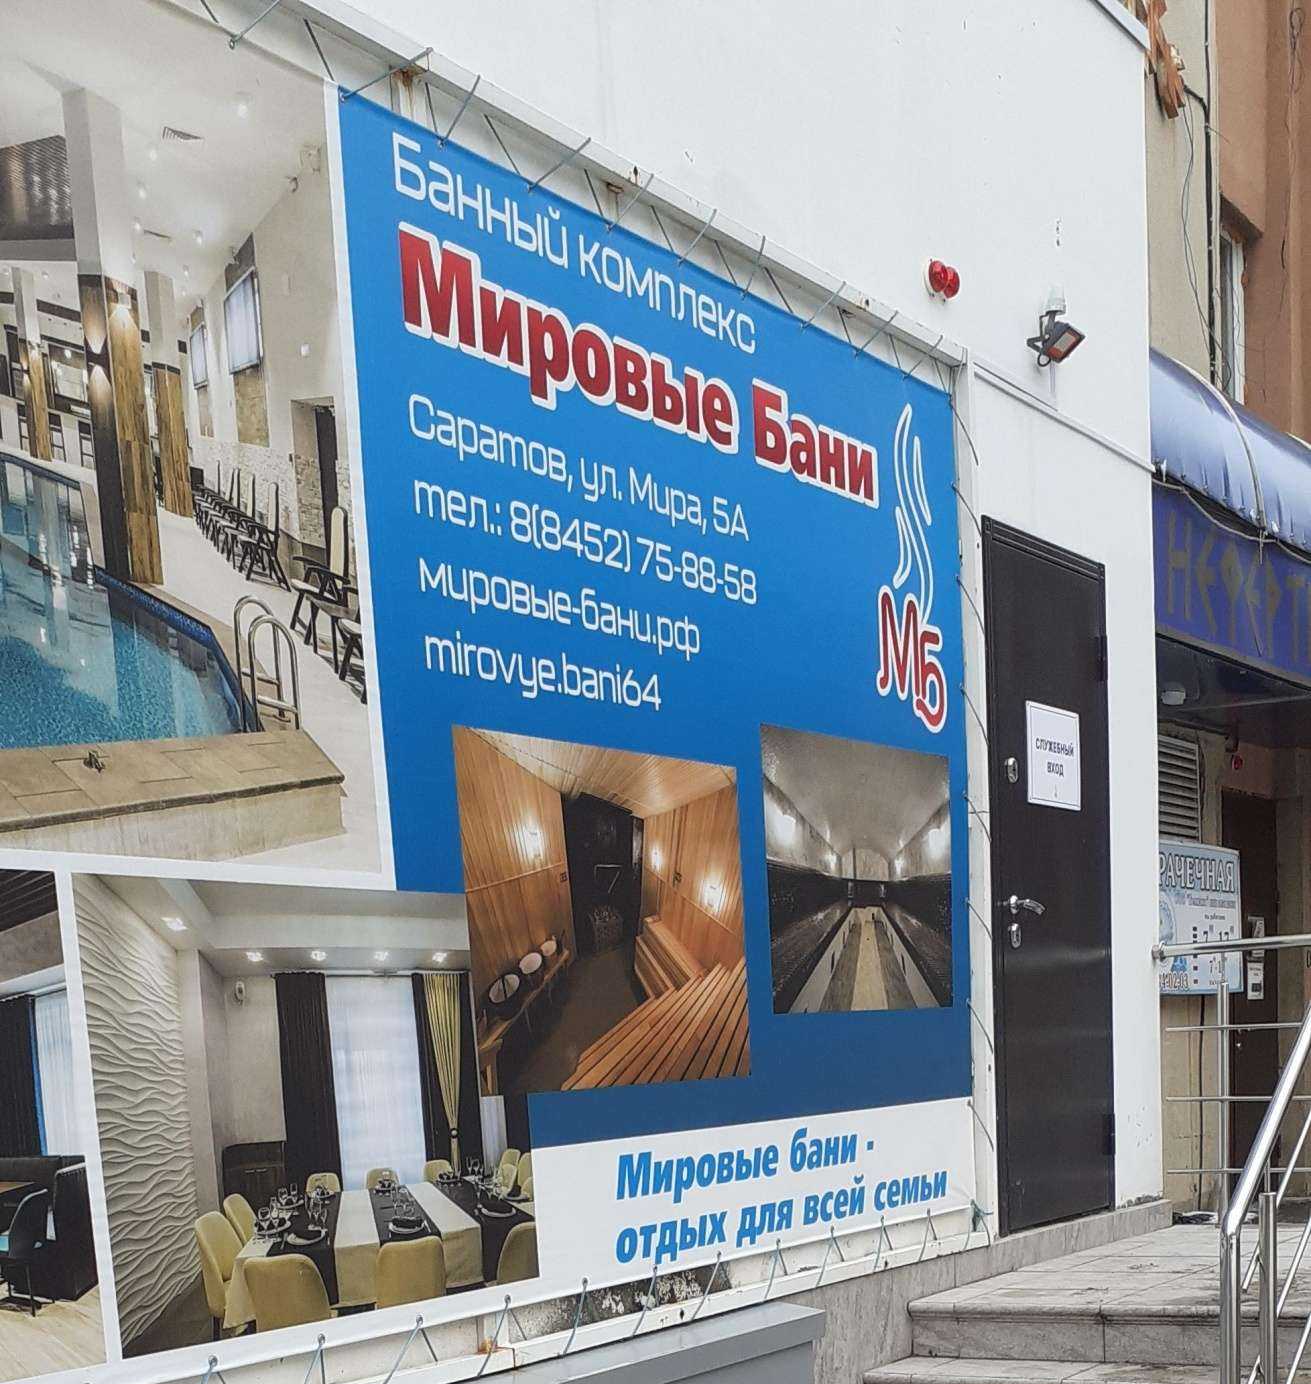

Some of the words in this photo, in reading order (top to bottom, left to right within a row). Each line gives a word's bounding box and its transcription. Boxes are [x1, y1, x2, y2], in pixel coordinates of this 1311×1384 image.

[392, 132, 569, 268] Банный
[578, 231, 756, 354] комплекс
[399, 222, 738, 453] Мировые
[751, 379, 879, 508] Бани
[409, 393, 573, 492] Саратов,
[580, 457, 623, 502] ул.
[630, 467, 708, 534] Мира,
[414, 479, 502, 534] тел.:
[510, 500, 632, 574] 8(8452)
[637, 537, 757, 604] 75-88-58
[418, 557, 700, 661] мировые-бани.рф
[424, 632, 662, 711] mirovye.bani64
[1035, 738, 1074, 757] СЛУЖЕБНЫЙ
[1047, 762, 1064, 777] ВХОД
[616, 1143, 779, 1203] Мировые
[790, 1127, 858, 1173] бани
[615, 1211, 727, 1265] отдых
[735, 1199, 794, 1248] для
[803, 1174, 866, 1224] всей
[874, 1171, 948, 1212] семьи
